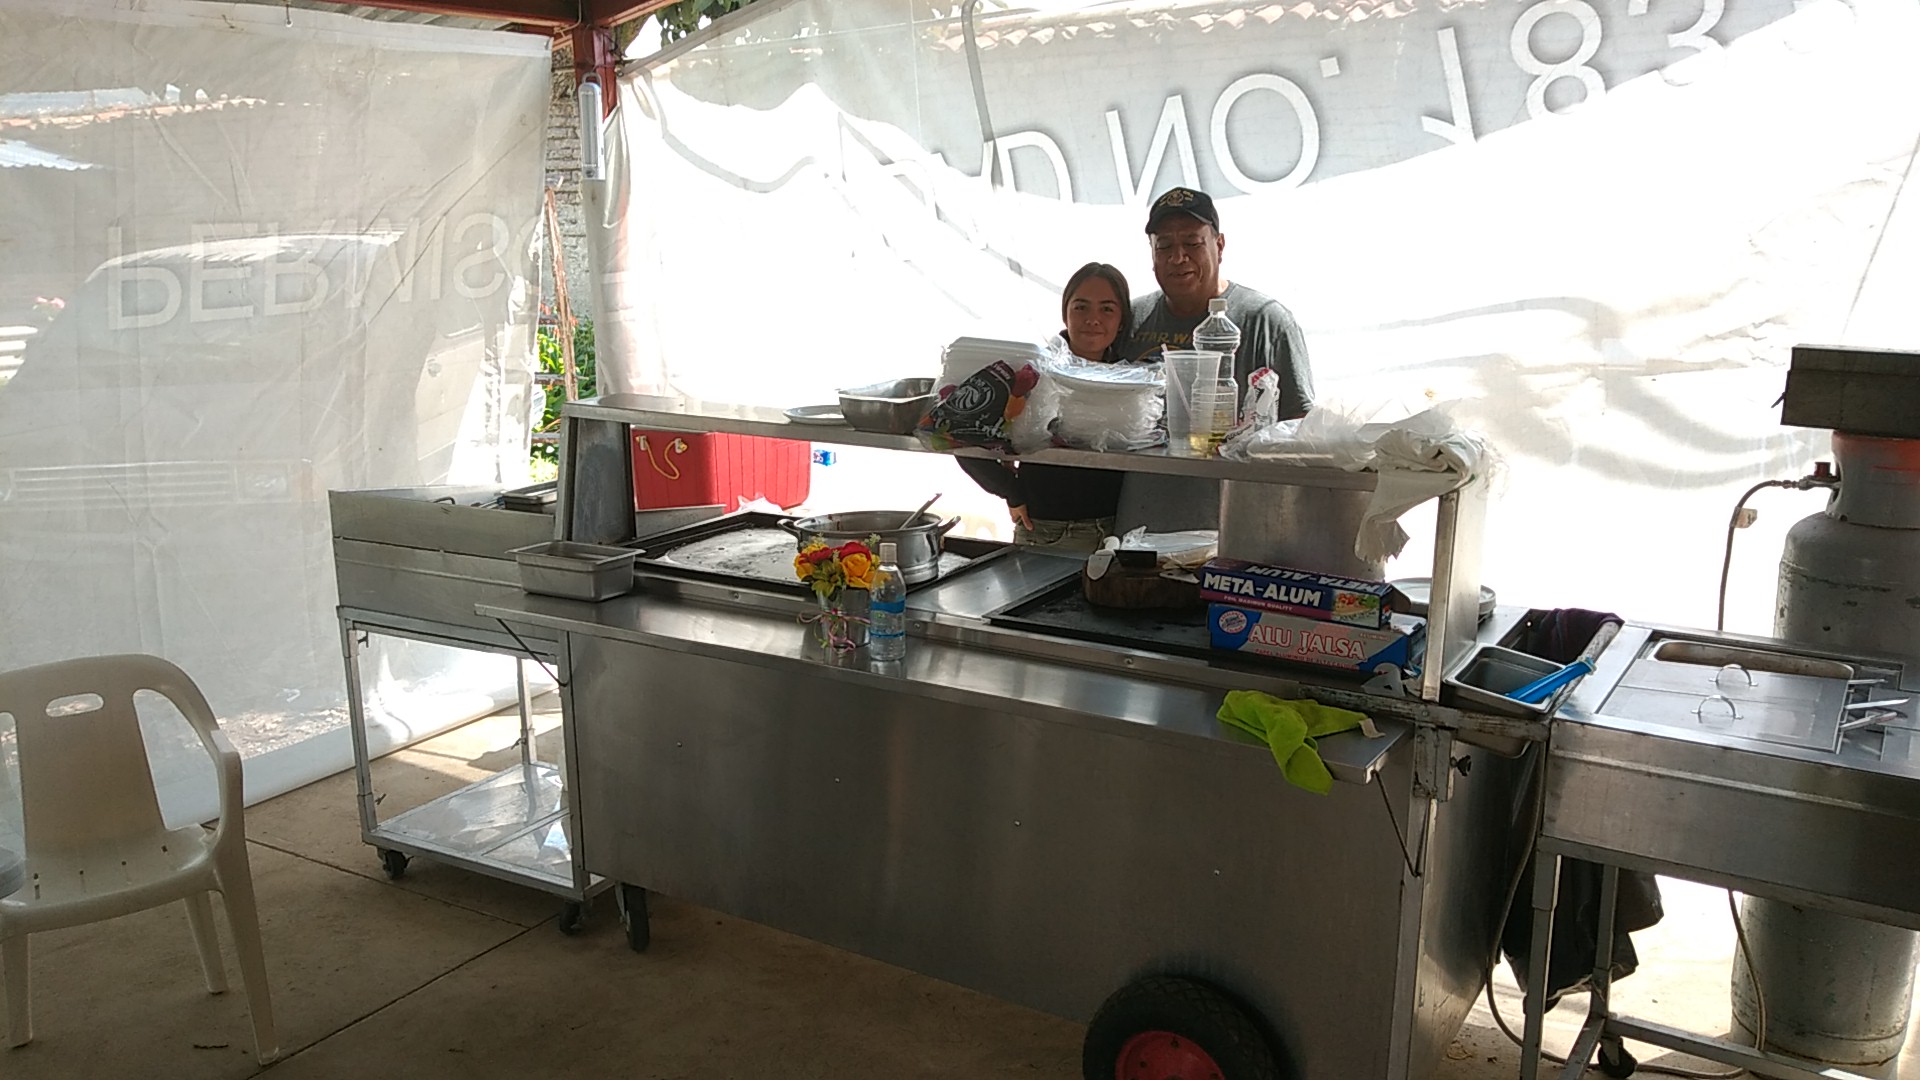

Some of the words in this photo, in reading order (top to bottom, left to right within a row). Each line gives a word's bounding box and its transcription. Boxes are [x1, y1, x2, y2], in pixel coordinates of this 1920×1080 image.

[1203, 572, 1321, 607] META-ALUM
[1267, 602, 1293, 611] QUALITY
[1248, 622, 1292, 648] ALU
[1298, 630, 1366, 661] JALSA
